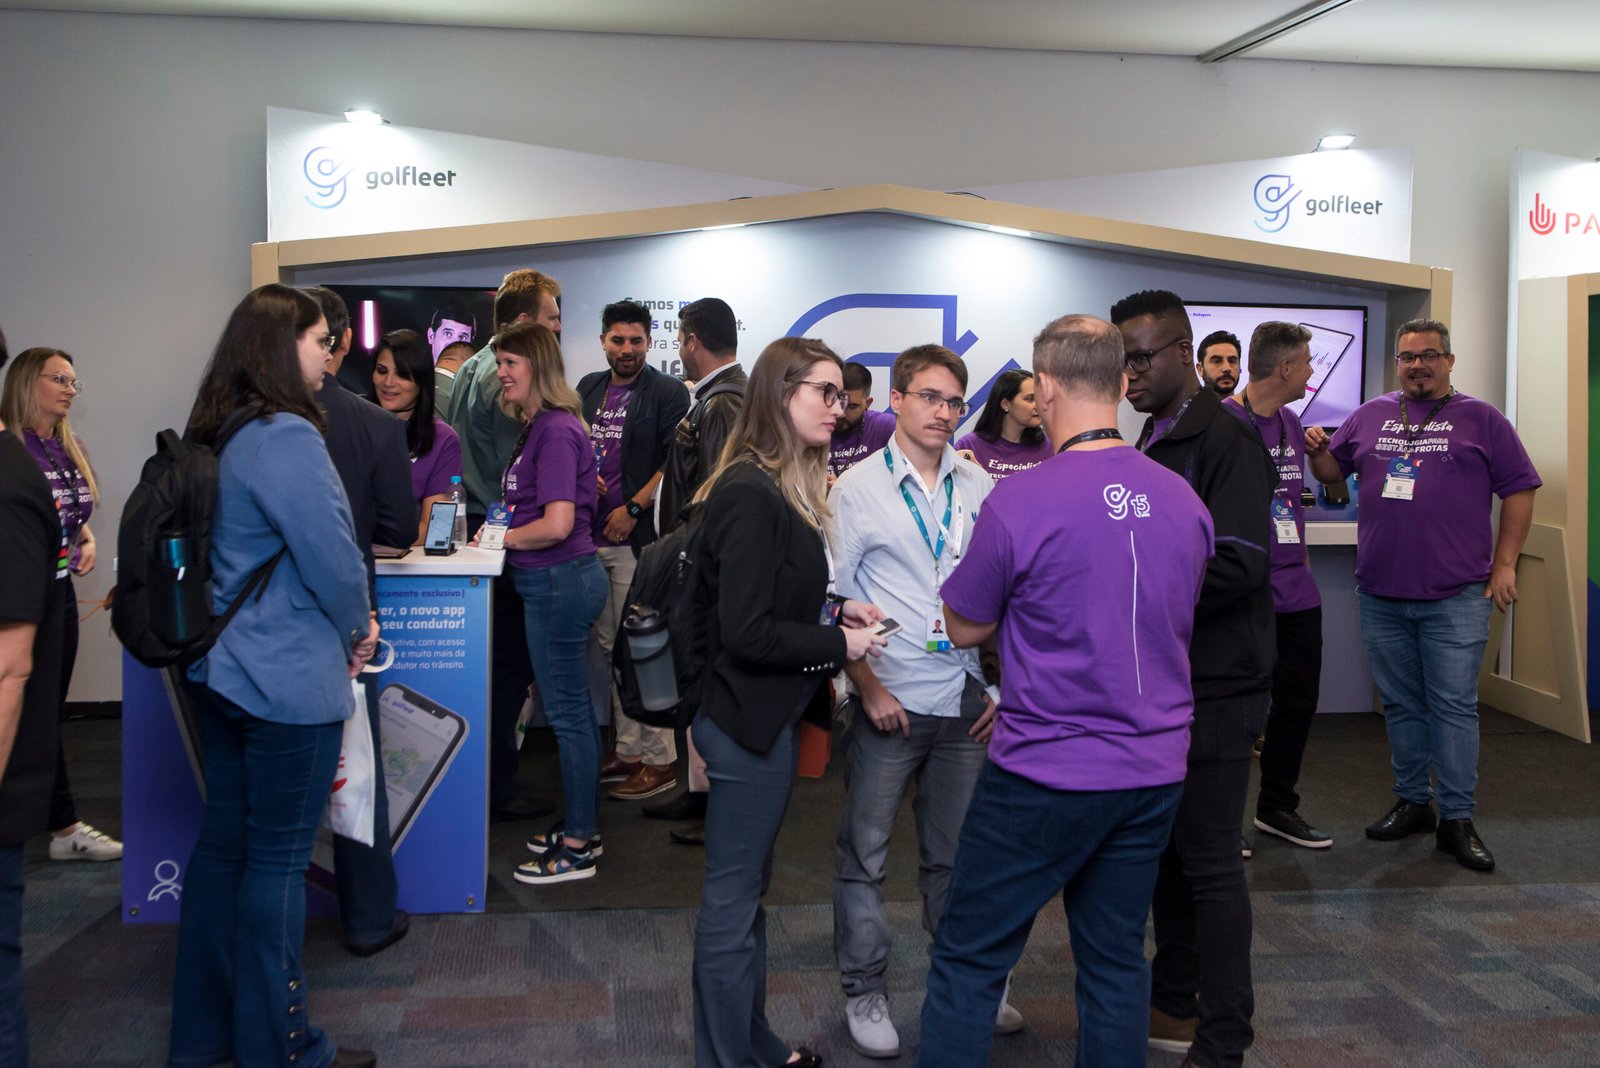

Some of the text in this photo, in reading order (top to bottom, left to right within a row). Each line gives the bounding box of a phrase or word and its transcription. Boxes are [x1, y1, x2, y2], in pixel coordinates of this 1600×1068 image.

[365, 166, 456, 190] golfleet
[1306, 195, 1382, 216] golfleet
[1565, 212, 1600, 234] PA
[624, 297, 674, 310] omos
[663, 320, 679, 332] qu
[1381, 420, 1454, 434] Espcalista
[1414, 445, 1449, 453] FROTAS
[378, 606, 466, 617] er, o novo app
[382, 618, 466, 630] seu condutor!
[408, 649, 432, 658] muito
[433, 649, 453, 658] mais
[454, 648, 466, 658] da
[389, 661, 417, 670] ndutor
